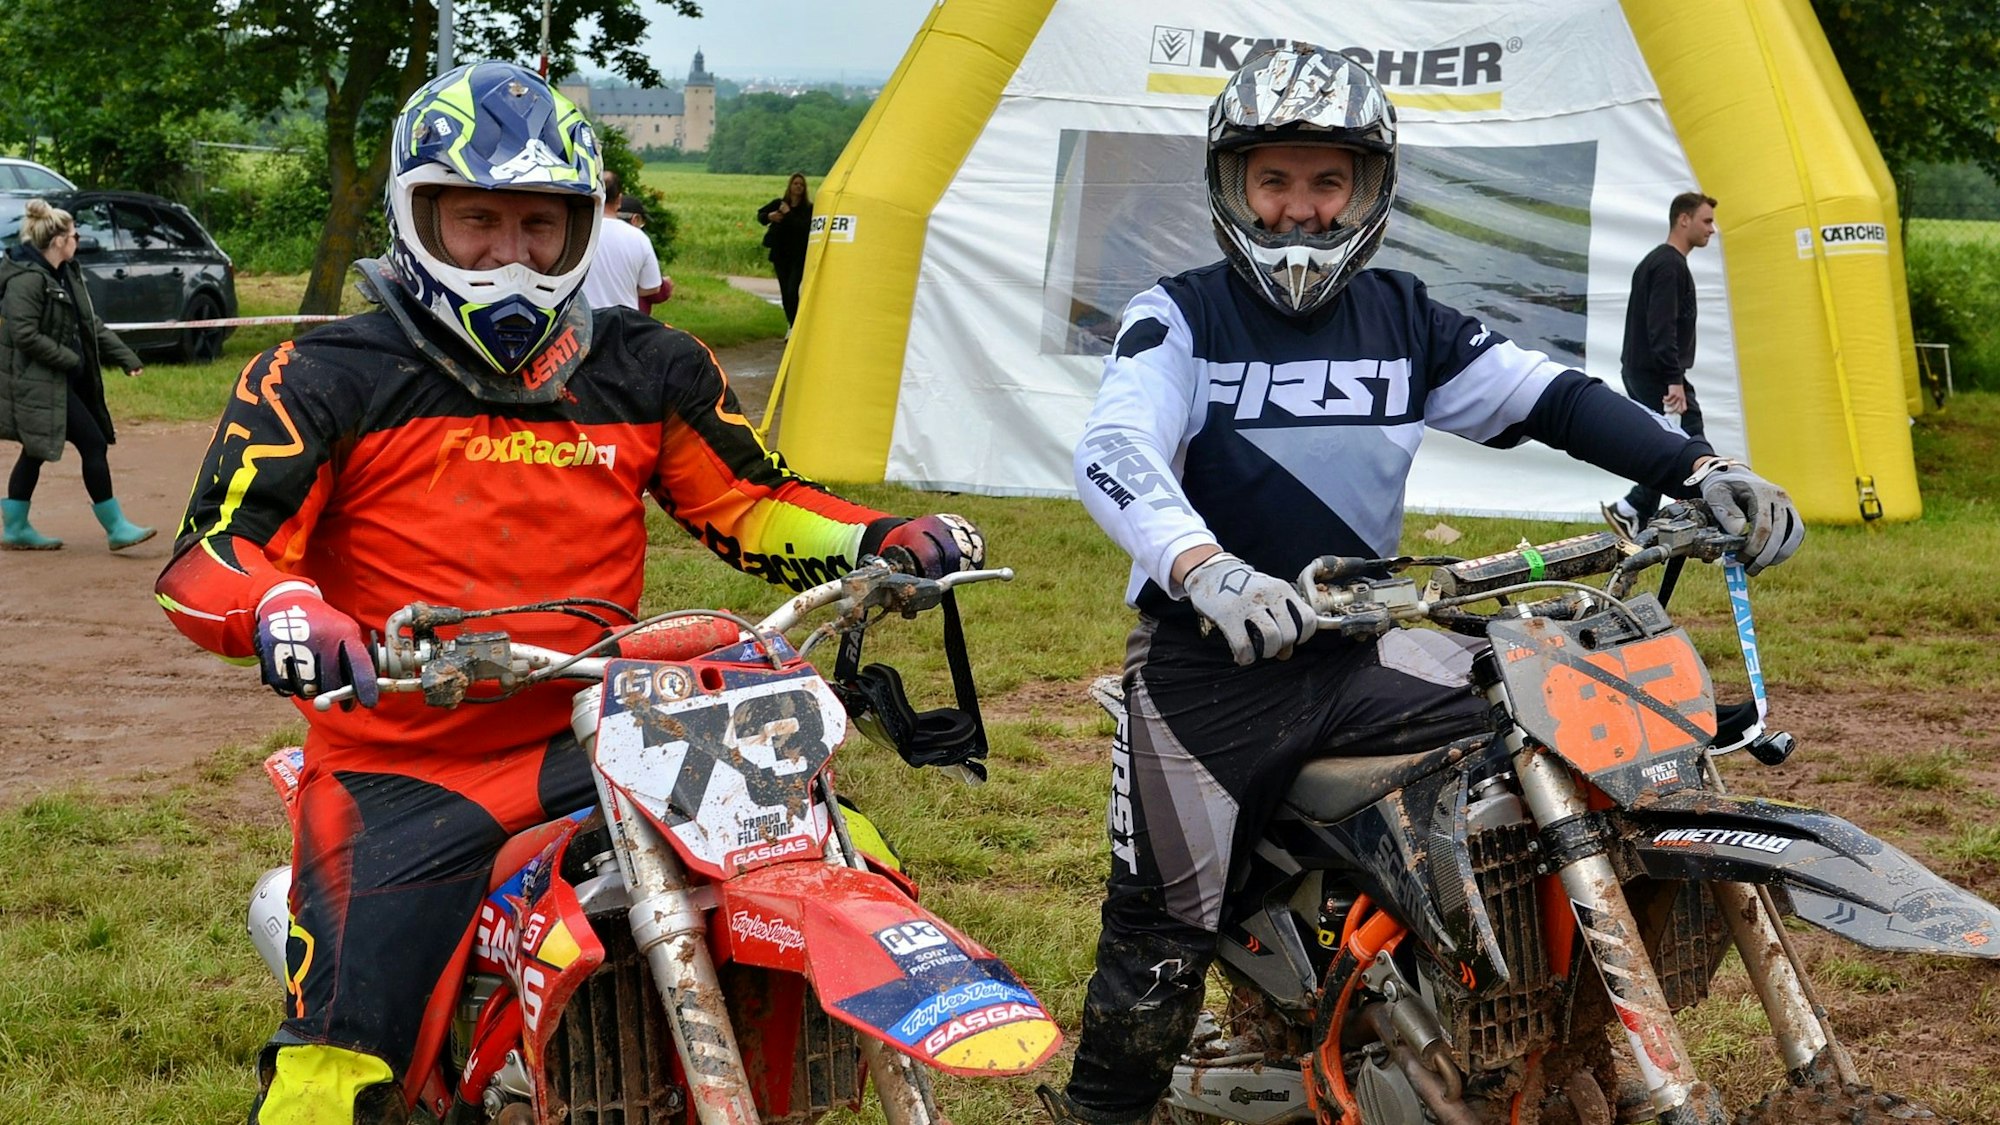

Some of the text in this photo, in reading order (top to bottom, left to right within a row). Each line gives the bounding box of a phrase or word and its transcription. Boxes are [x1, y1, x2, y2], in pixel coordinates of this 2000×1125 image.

[521, 326, 580, 391] LEATT
[1207, 357, 1412, 420] FIRST
[1085, 431, 1194, 516] FIRST
[1086, 461, 1137, 511] RACING
[1724, 564, 1767, 701] RAVEN
[1112, 703, 1138, 875] FIRST
[732, 838, 809, 866] GASGAS
[1653, 829, 1793, 854] NINETYTWO
[884, 921, 943, 950] PPG
[914, 948, 949, 963] SONY
[908, 953, 969, 977] PICTURES
[901, 1003, 938, 1036] Troy
[936, 989, 970, 1015] Lee
[924, 1003, 1047, 1056] GASGAS
